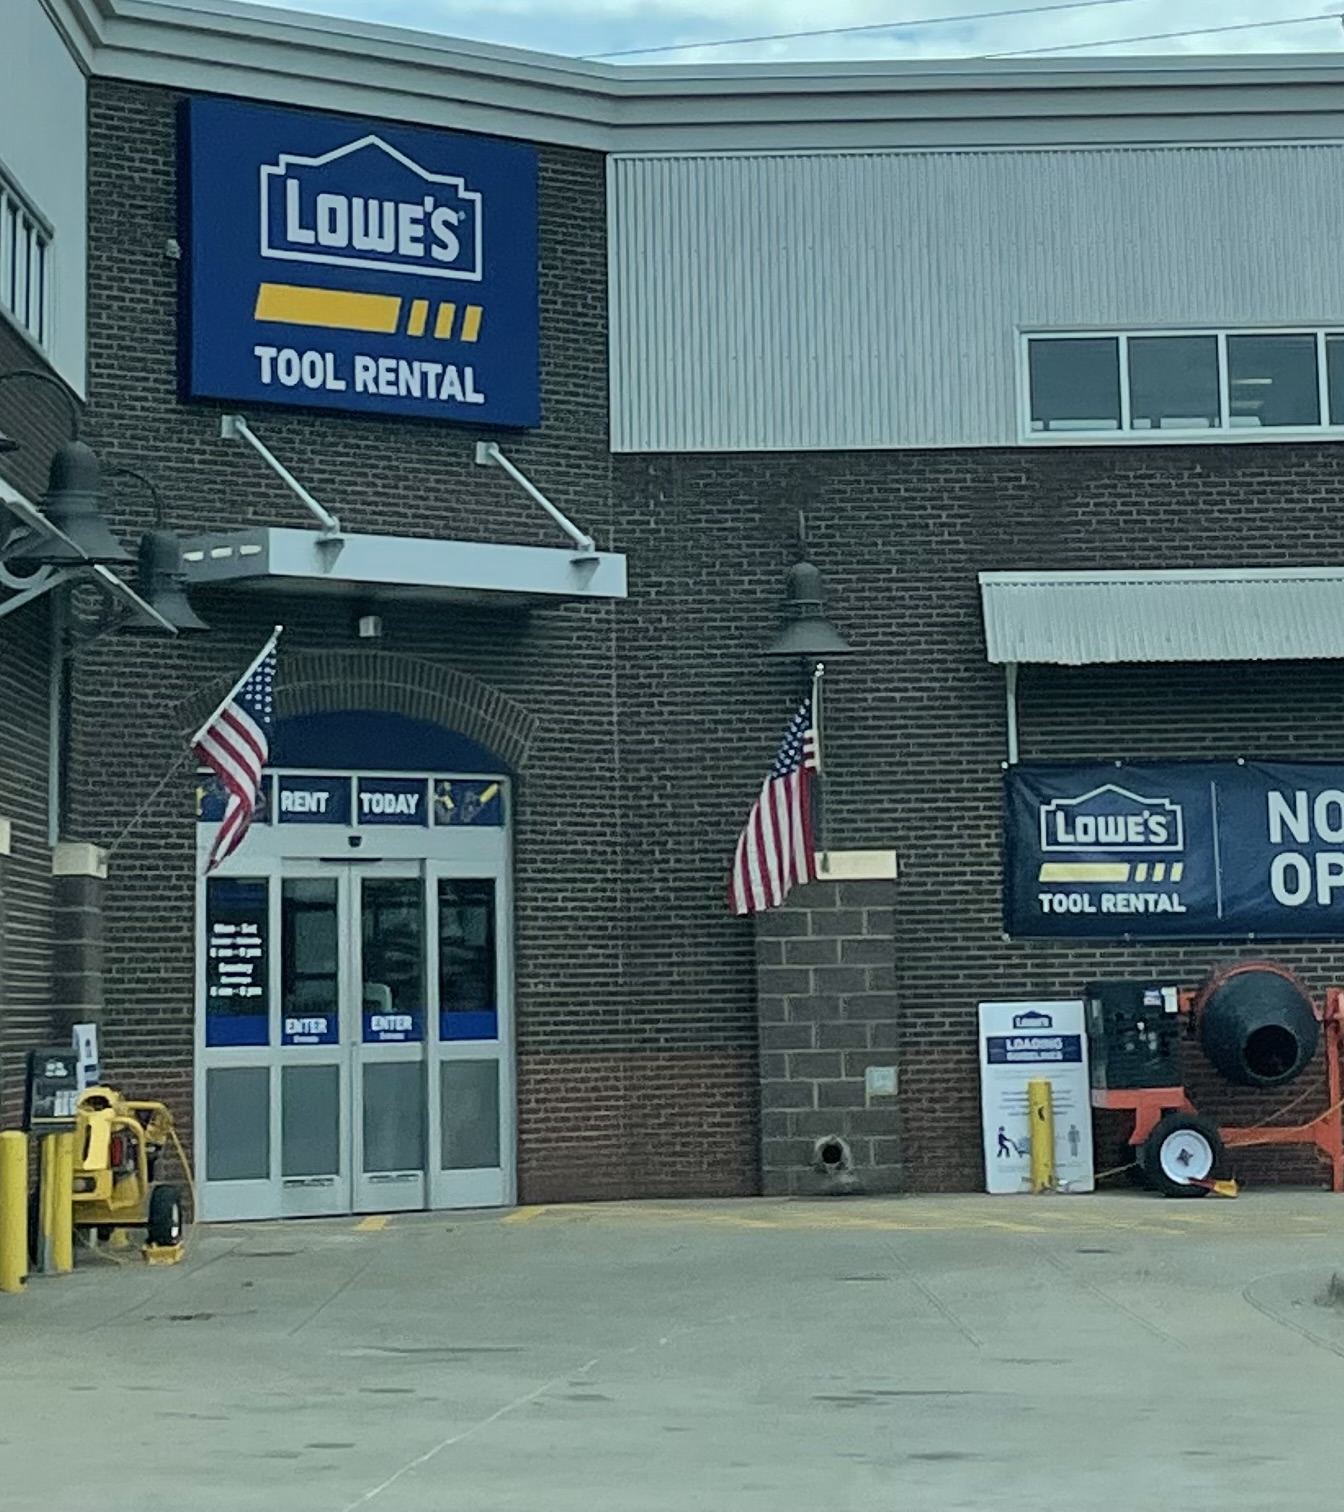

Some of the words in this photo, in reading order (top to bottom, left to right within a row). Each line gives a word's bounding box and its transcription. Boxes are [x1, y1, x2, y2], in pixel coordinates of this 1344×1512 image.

[286, 178, 460, 262] LOWE'S
[254, 345, 346, 391] TOOL
[354, 355, 485, 404] RENTAL
[281, 790, 329, 813] RENT
[359, 792, 419, 814] TODAY
[1056, 809, 1168, 844] LOWE'S
[1038, 892, 1096, 914] TOOL
[1101, 892, 1186, 914] RENTAL
[285, 1017, 328, 1035] ENTER
[371, 1015, 413, 1031] ENTER
